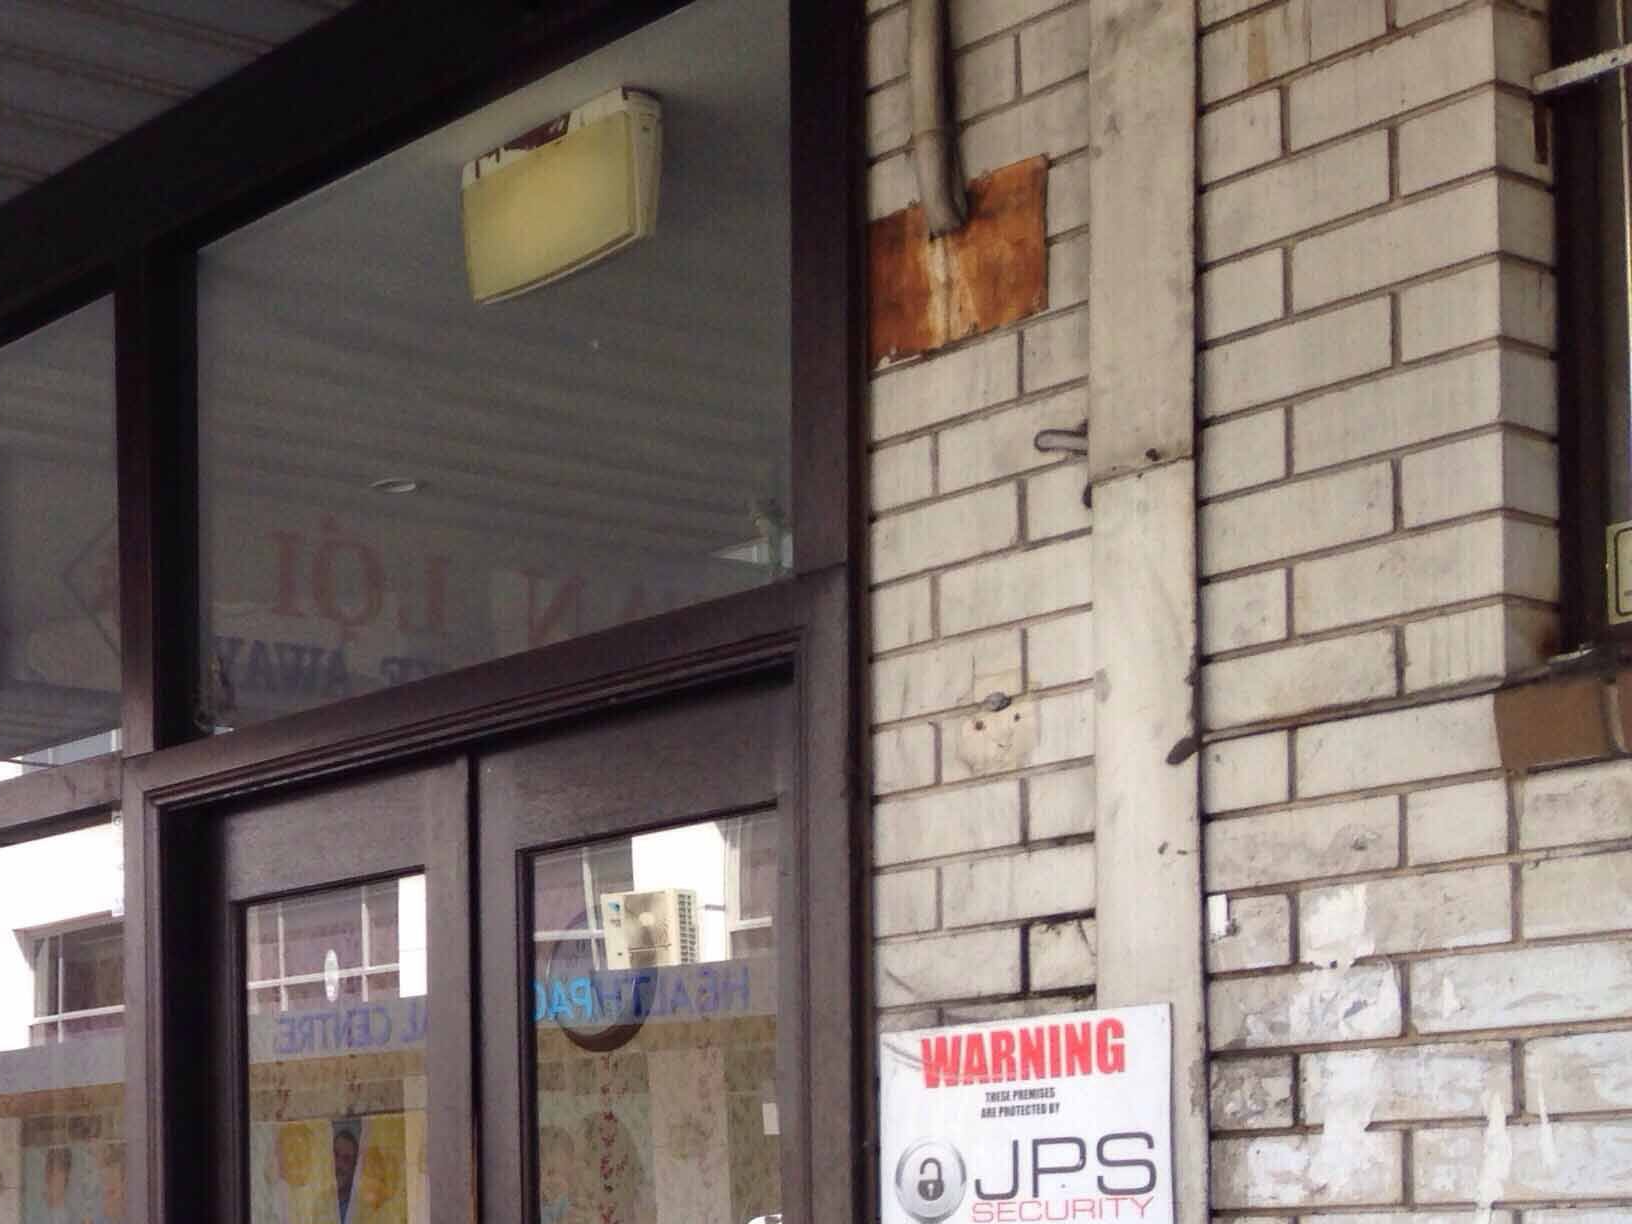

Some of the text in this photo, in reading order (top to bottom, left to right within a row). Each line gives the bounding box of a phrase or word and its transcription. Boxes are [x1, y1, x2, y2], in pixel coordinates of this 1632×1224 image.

[922, 1018, 1126, 1088] WARNING
[985, 1087, 1056, 1103] THESE PREMISES
[981, 1102, 1060, 1119] ARE PROTECTED BY
[975, 1131, 1157, 1200] JPS
[972, 1196, 1154, 1223] SECURITY
